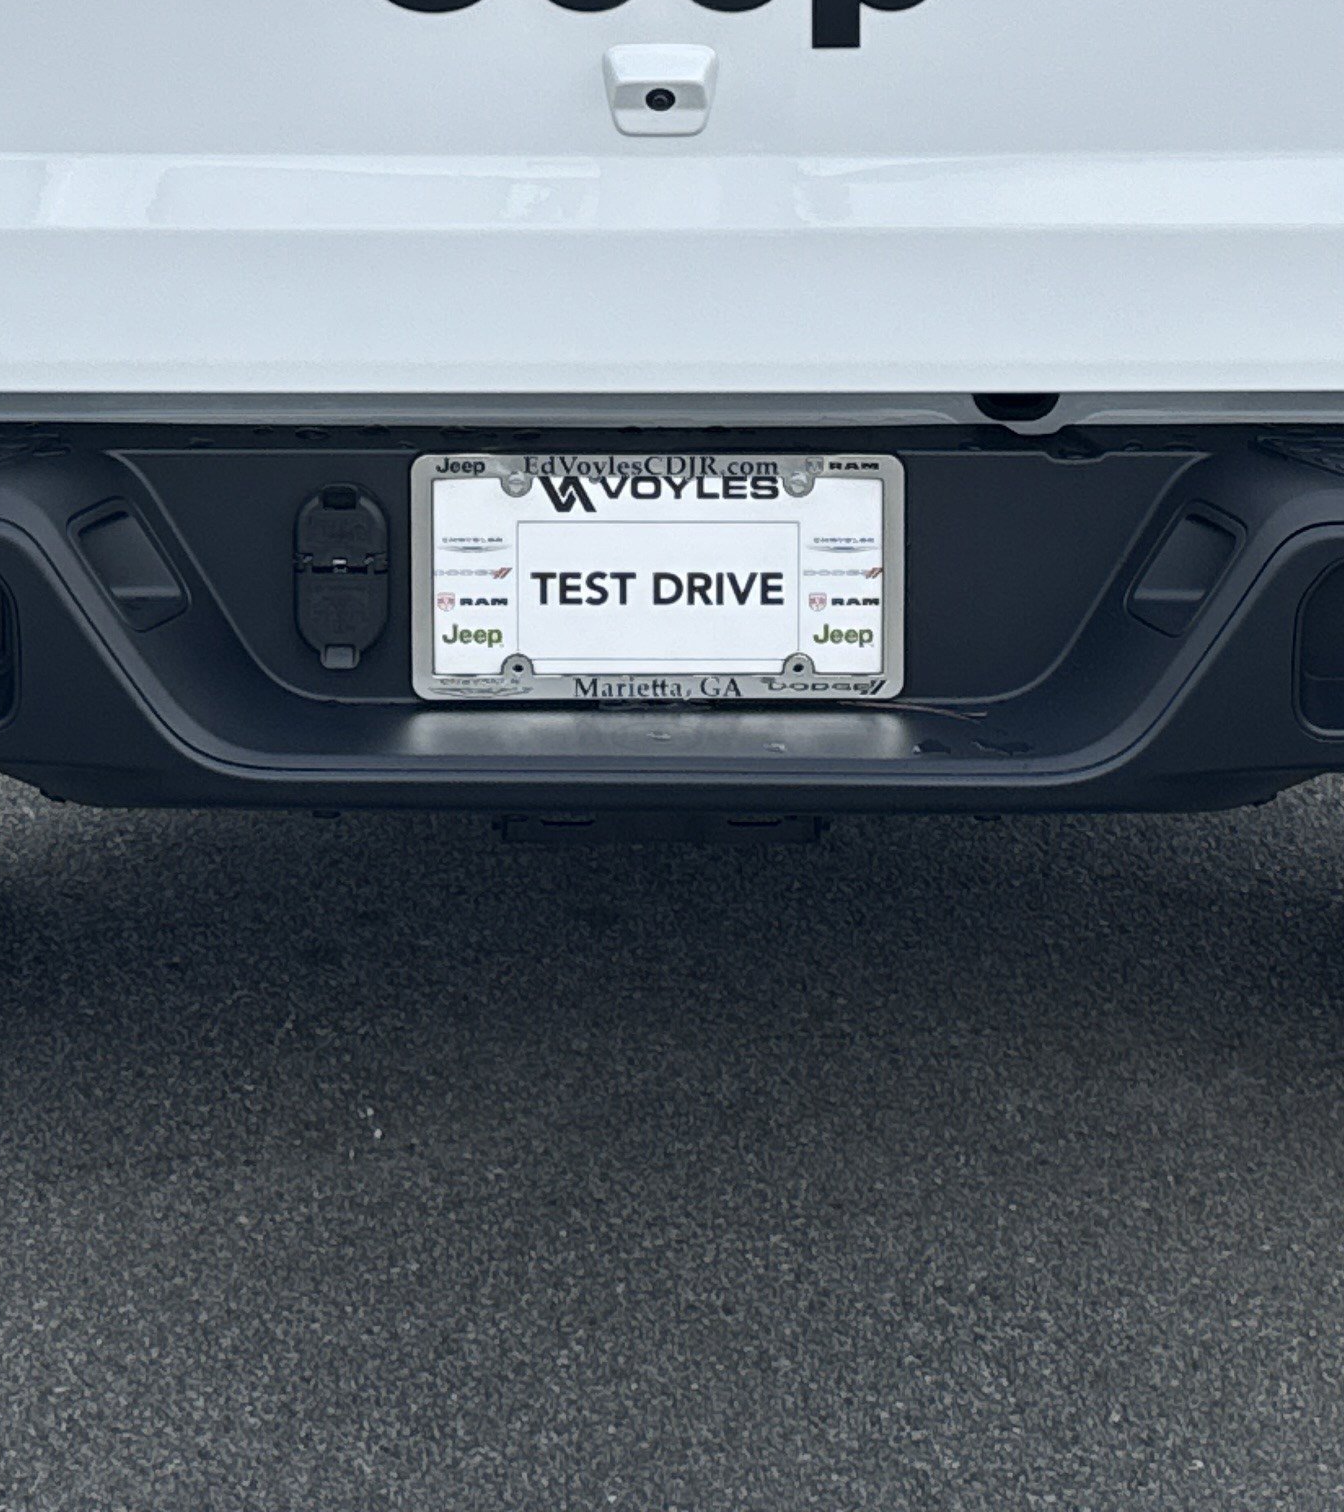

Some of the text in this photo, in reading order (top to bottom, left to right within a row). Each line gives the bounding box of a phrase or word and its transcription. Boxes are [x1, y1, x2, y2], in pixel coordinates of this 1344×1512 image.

[436, 456, 486, 476] Jeep
[522, 455, 780, 480] EdVoylesCDJR.com
[828, 462, 880, 471] RAM
[600, 475, 780, 500] VOYLES
[530, 571, 785, 606] TEST DRIVE
[459, 597, 509, 606] RAM
[830, 597, 880, 606] RAM
[442, 623, 503, 648] Jeep
[813, 623, 874, 648] Jeep
[574, 677, 743, 699] Marietta, GA
